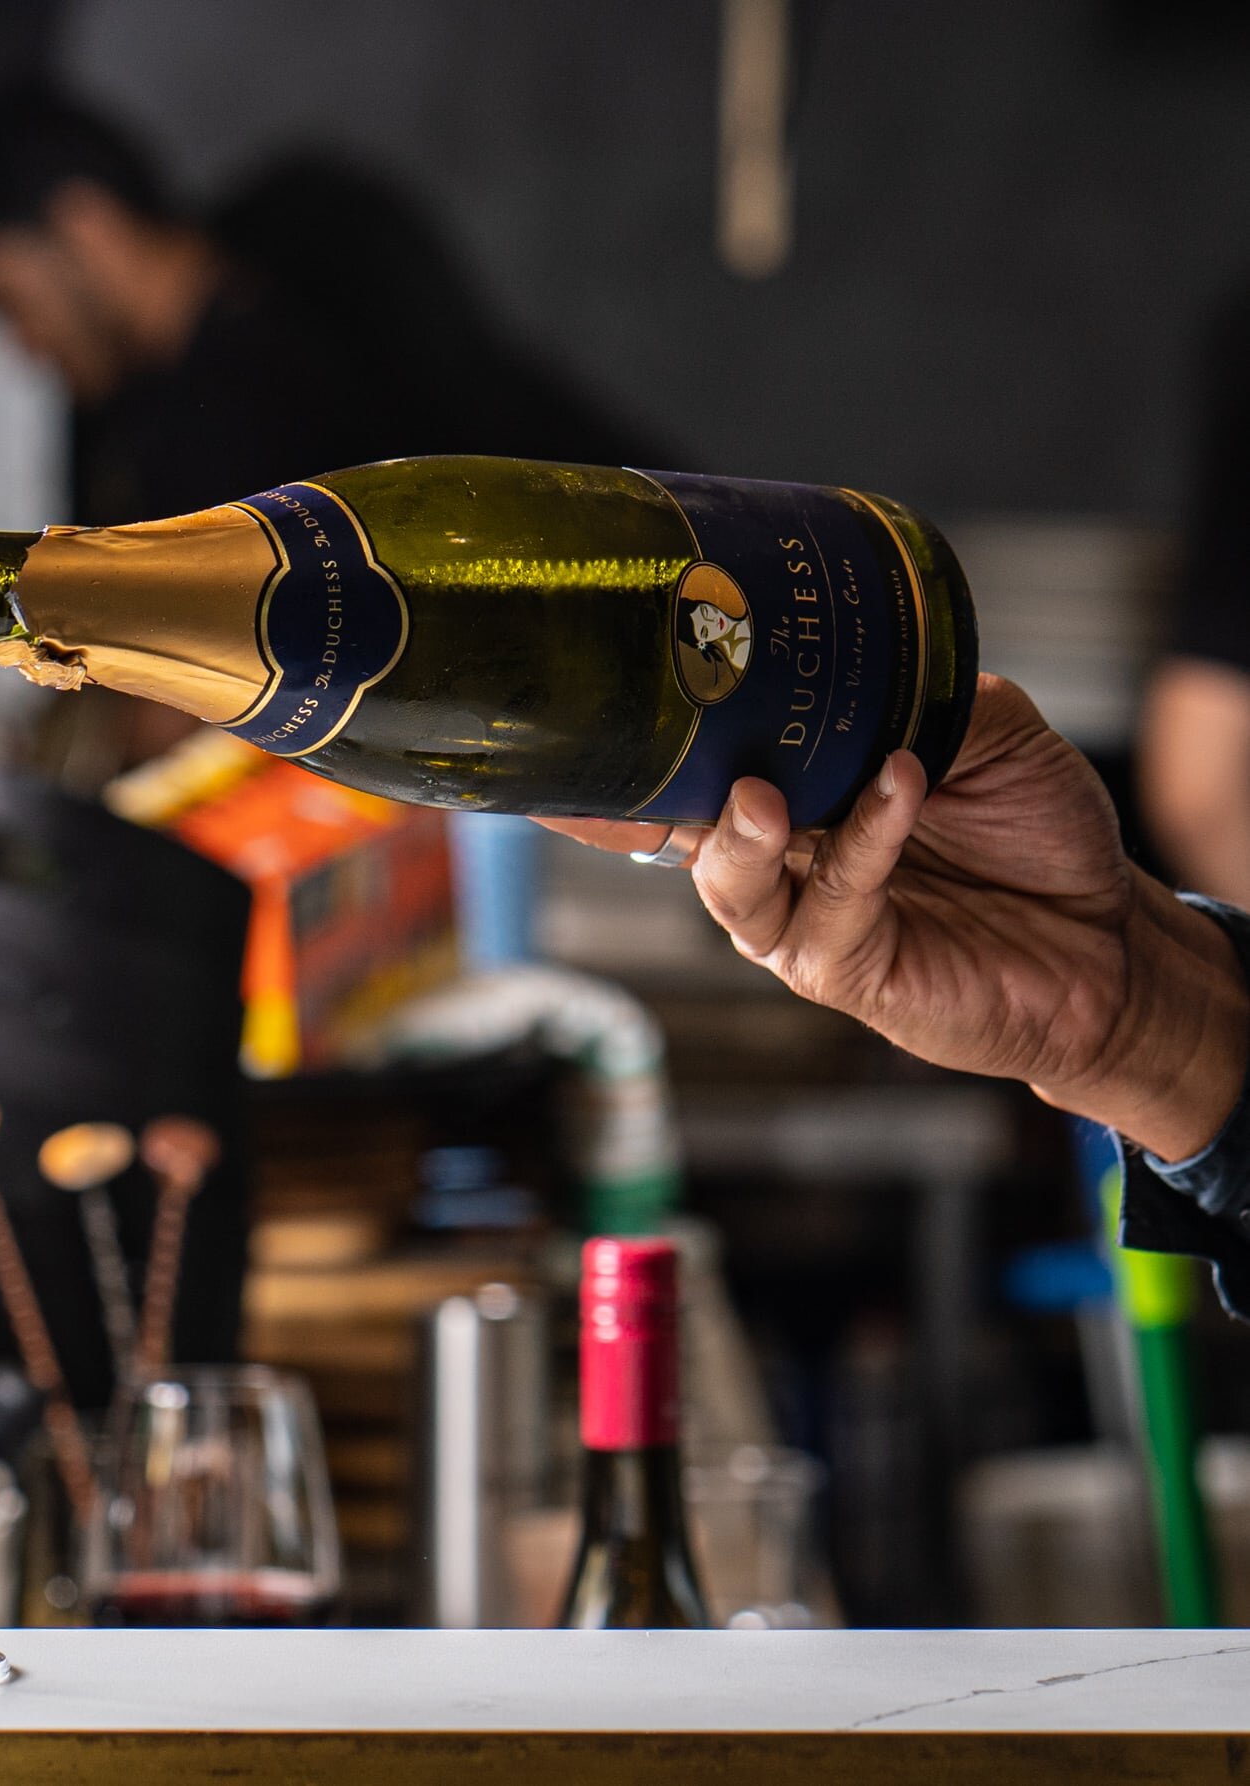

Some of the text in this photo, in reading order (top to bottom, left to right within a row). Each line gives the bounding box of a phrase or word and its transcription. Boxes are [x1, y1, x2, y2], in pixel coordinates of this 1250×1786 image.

[322, 560, 343, 664] DUCHESS
[770, 615, 791, 660] The
[778, 537, 821, 747] DUCHESS
[846, 617, 868, 688] Vintage
[889, 568, 910, 729] PRODUCT OF AUSTRALIA
[315, 669, 333, 690] The
[252, 697, 319, 745] DUCHESS
[836, 700, 857, 733] Non
